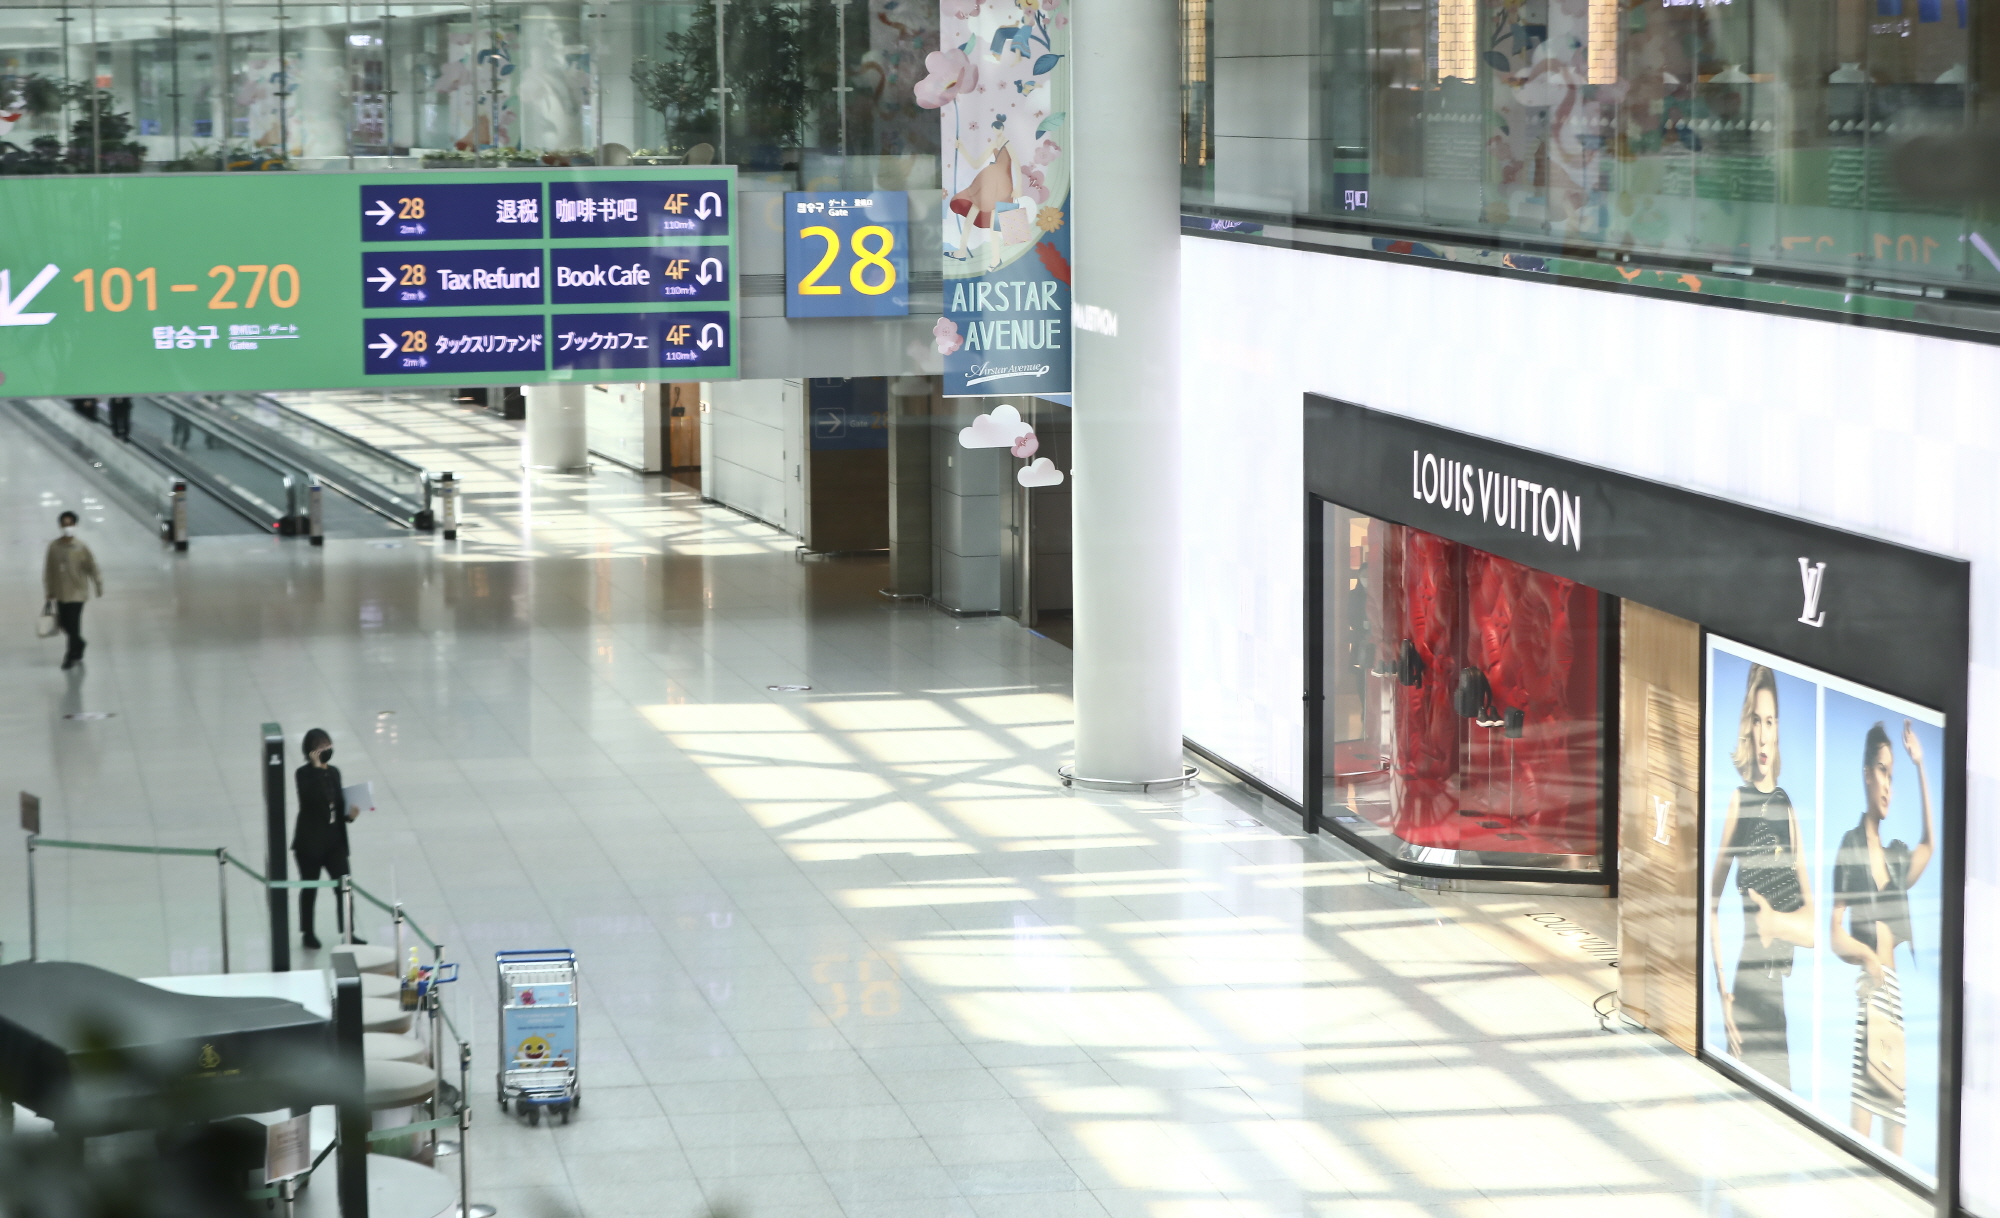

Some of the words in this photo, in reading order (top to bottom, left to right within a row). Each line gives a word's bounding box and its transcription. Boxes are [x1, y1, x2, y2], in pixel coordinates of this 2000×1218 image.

[398, 197, 425, 220] 28
[496, 199, 539, 223] 退税
[555, 198, 638, 223] 咖啡书吧
[664, 193, 689, 214] 4F
[828, 208, 849, 217] Gate
[665, 259, 691, 280] 4F
[798, 225, 896, 295] 28
[400, 264, 427, 286] 28
[437, 269, 472, 291] Tax
[473, 266, 540, 290] Refund
[557, 264, 607, 287] Book
[608, 263, 650, 286] Cafe
[72, 267, 158, 313] 101
[207, 263, 300, 310] 270
[951, 281, 1062, 313] AIRSTAR
[152, 324, 220, 350] 탑승구
[401, 330, 428, 353] 28
[435, 334, 542, 355] タックスリファンド
[558, 332, 650, 352] ブックカフェ
[666, 325, 692, 346] 4F
[964, 319, 1061, 351] AVENUE
[965, 361, 1008, 378] Airstar
[1008, 363, 1041, 374] Avenue
[849, 419, 869, 428] Gate
[1413, 450, 1473, 517] LOUIS
[1478, 468, 1581, 552] VUITTON
[1524, 912, 1590, 936] LOUIS
